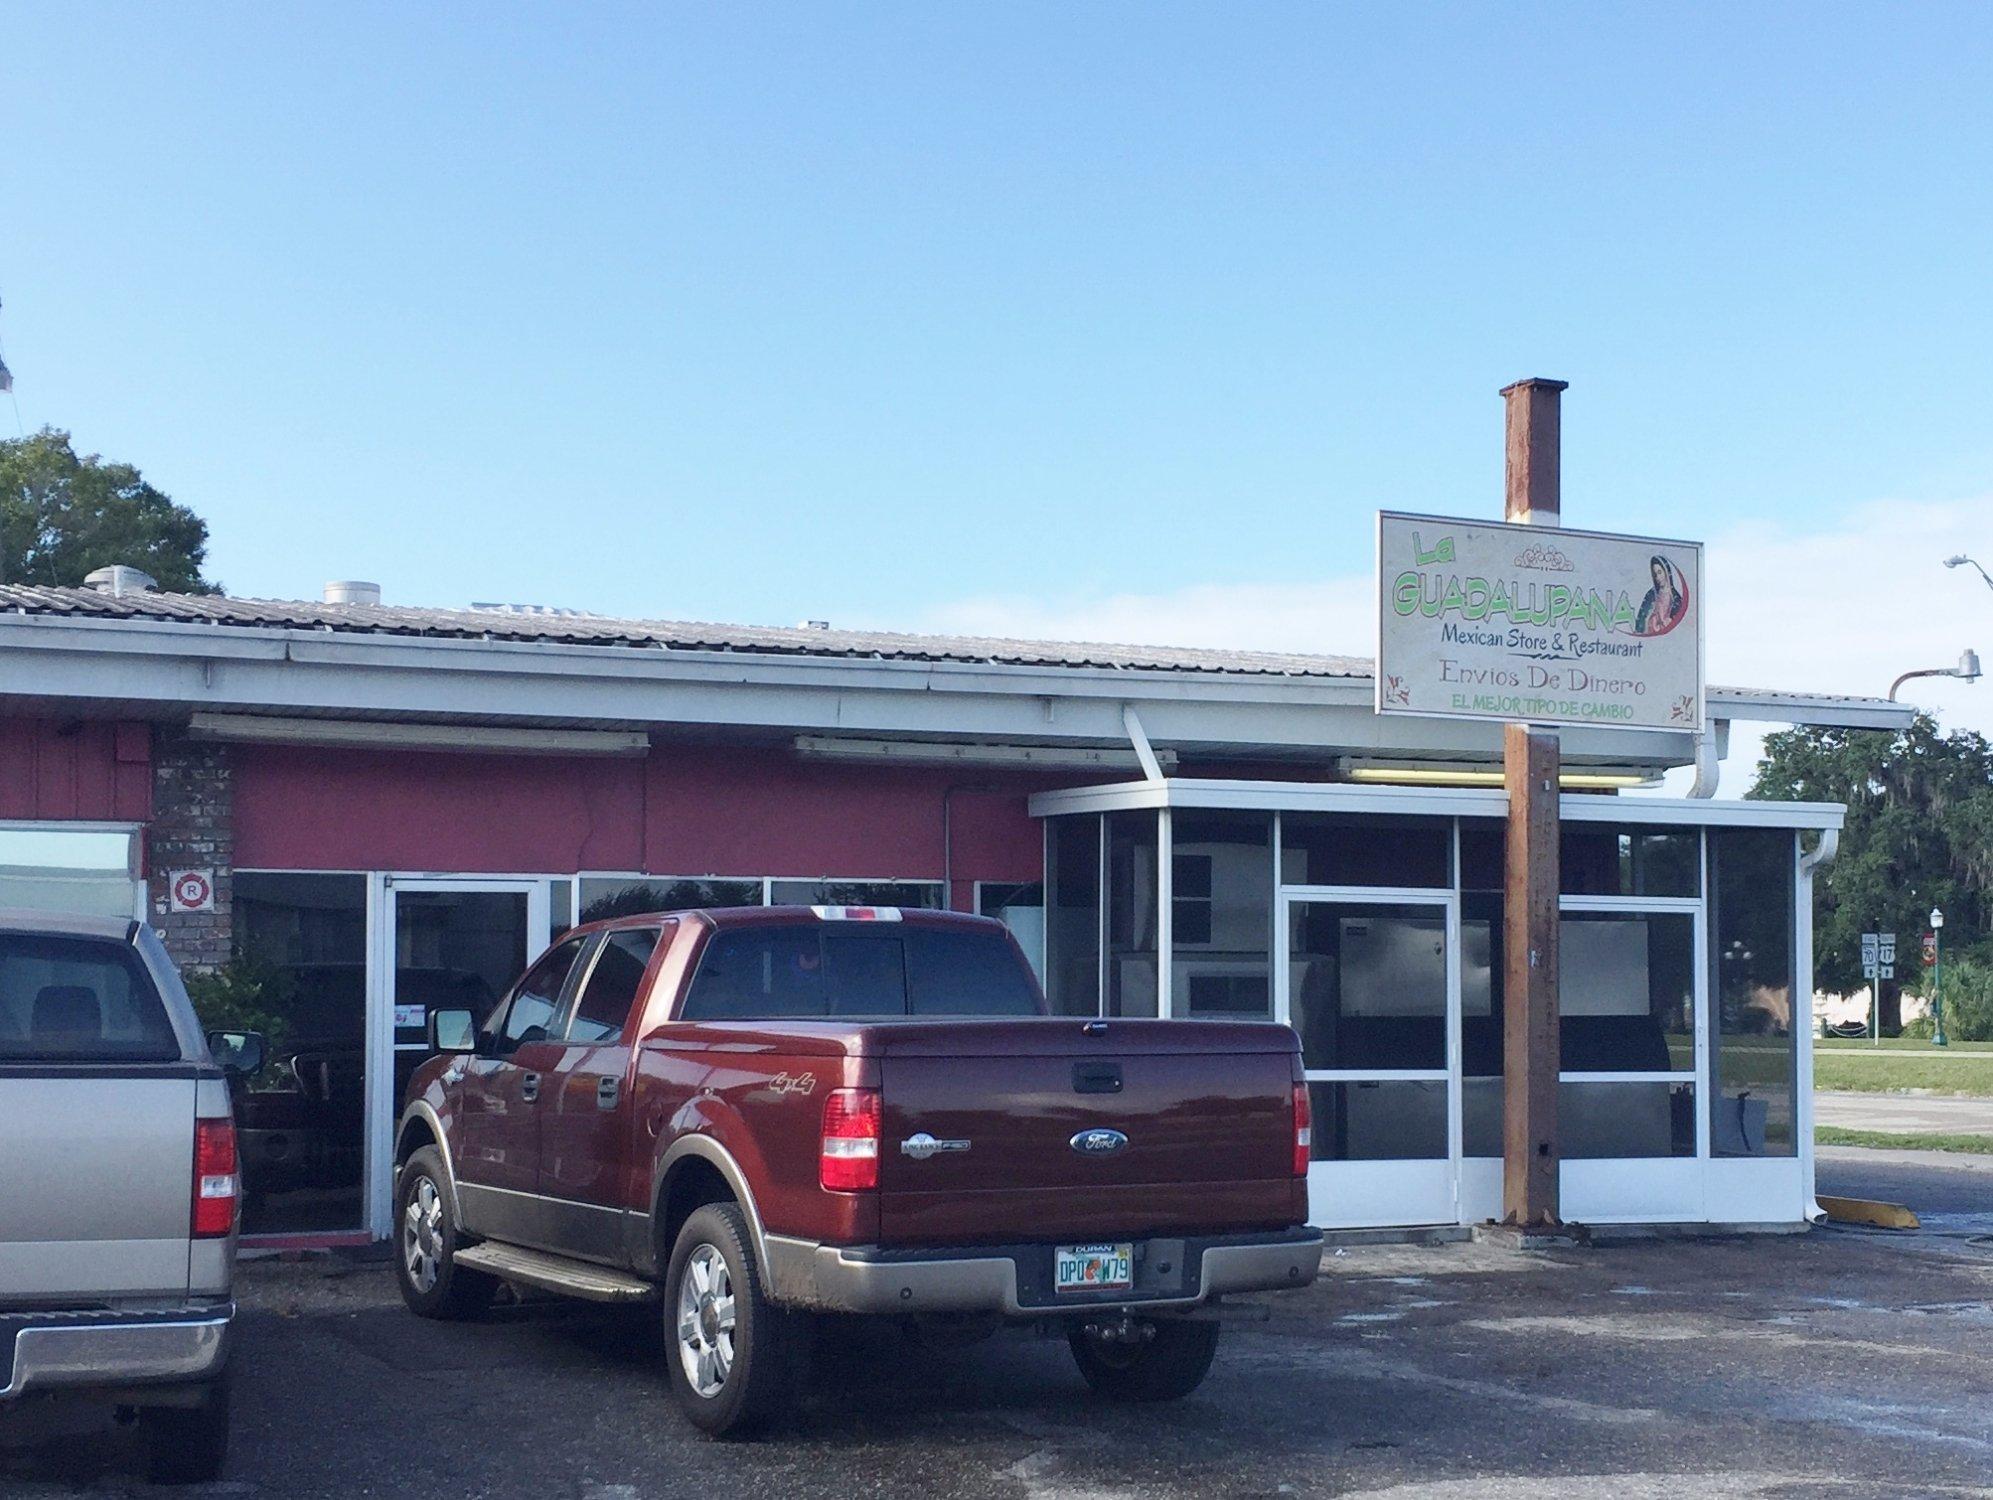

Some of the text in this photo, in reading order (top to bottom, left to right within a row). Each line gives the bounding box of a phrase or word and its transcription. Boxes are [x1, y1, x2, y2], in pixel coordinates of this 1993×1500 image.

[1412, 531, 1456, 566] La
[1392, 571, 1637, 634] GUADALUPANA
[1441, 623, 1643, 657] Mexican Store & Restaurant
[1439, 659, 1646, 695] Envios De Dinero
[1452, 694, 1634, 719] EL MEJOR TIPO DE CAMBIO
[187, 885, 198, 896] R
[1864, 949, 1874, 962] 70
[1883, 948, 1893, 961] 17
[1086, 1133, 1117, 1149] Ford
